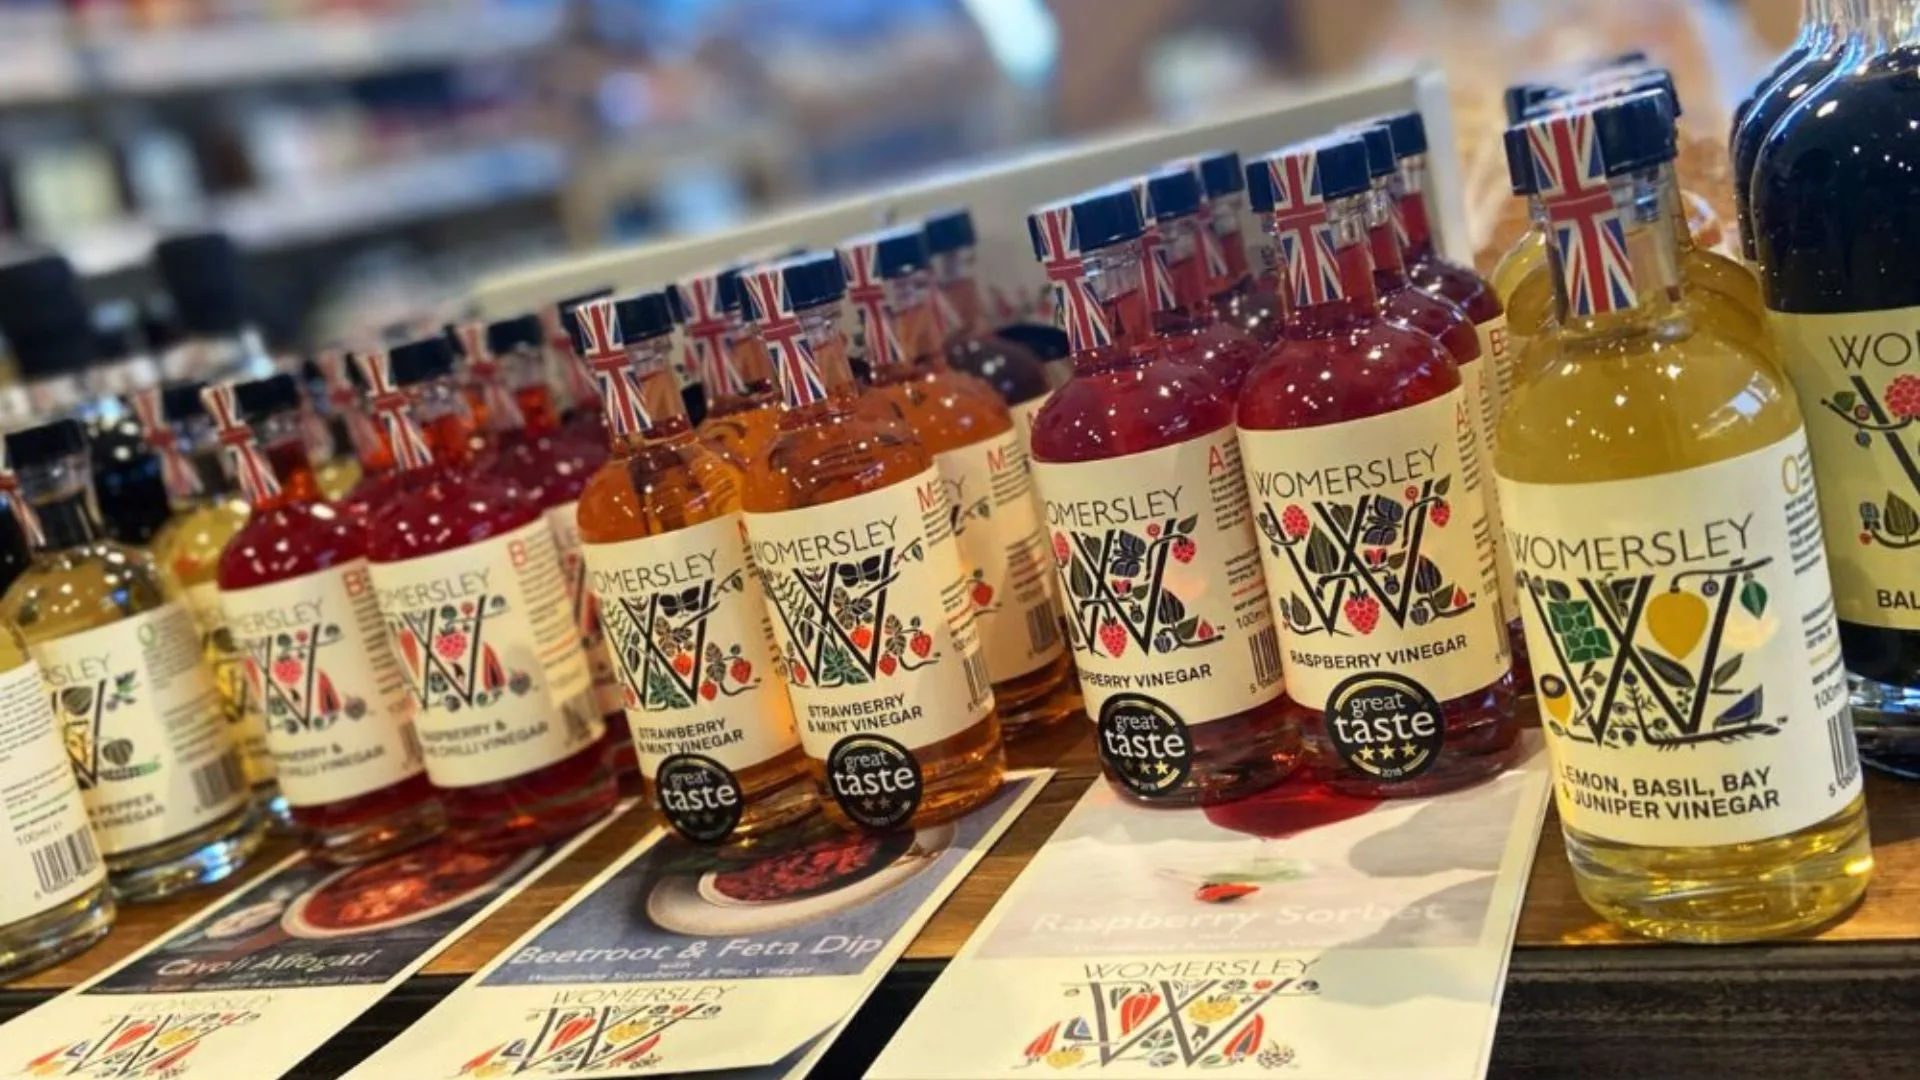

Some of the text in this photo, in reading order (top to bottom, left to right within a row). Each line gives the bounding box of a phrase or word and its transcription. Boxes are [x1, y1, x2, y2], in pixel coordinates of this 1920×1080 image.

[1829, 331, 1920, 369] WO
[1253, 444, 1439, 499] WOMERSLEY
[1047, 485, 1183, 527] OMERSLEY
[1509, 512, 1754, 573] WOMERSLEY
[593, 549, 717, 594] OMERSLEY
[1290, 634, 1468, 669] RASPBERRY VINEGAR
[1135, 663, 1212, 688] VINEGAR
[808, 693, 905, 718] STRAWBERRY
[815, 718, 849, 735] MINT
[850, 705, 923, 732] VINEGAR
[1350, 692, 1406, 718] great
[638, 717, 726, 740] STRAWBERRY
[1115, 713, 1159, 734] great
[1334, 710, 1436, 743] taste
[676, 728, 744, 753] VINEGAR
[1104, 728, 1186, 758] taste
[844, 751, 889, 773] great
[669, 768, 710, 788] great
[833, 767, 916, 796] taste
[1559, 761, 1772, 798] LEMON, BASIL, BAY
[661, 782, 737, 812] taste
[1574, 788, 1660, 819] JUNIPER
[1665, 788, 1780, 820] VINEGAR
[1031, 901, 1446, 937] Raspberry Sorbet
[511, 934, 885, 966] Beetroot & Feta Dip
[1083, 956, 1321, 979] WOMERSLEY
[552, 984, 738, 1004] WOMERSLEY
